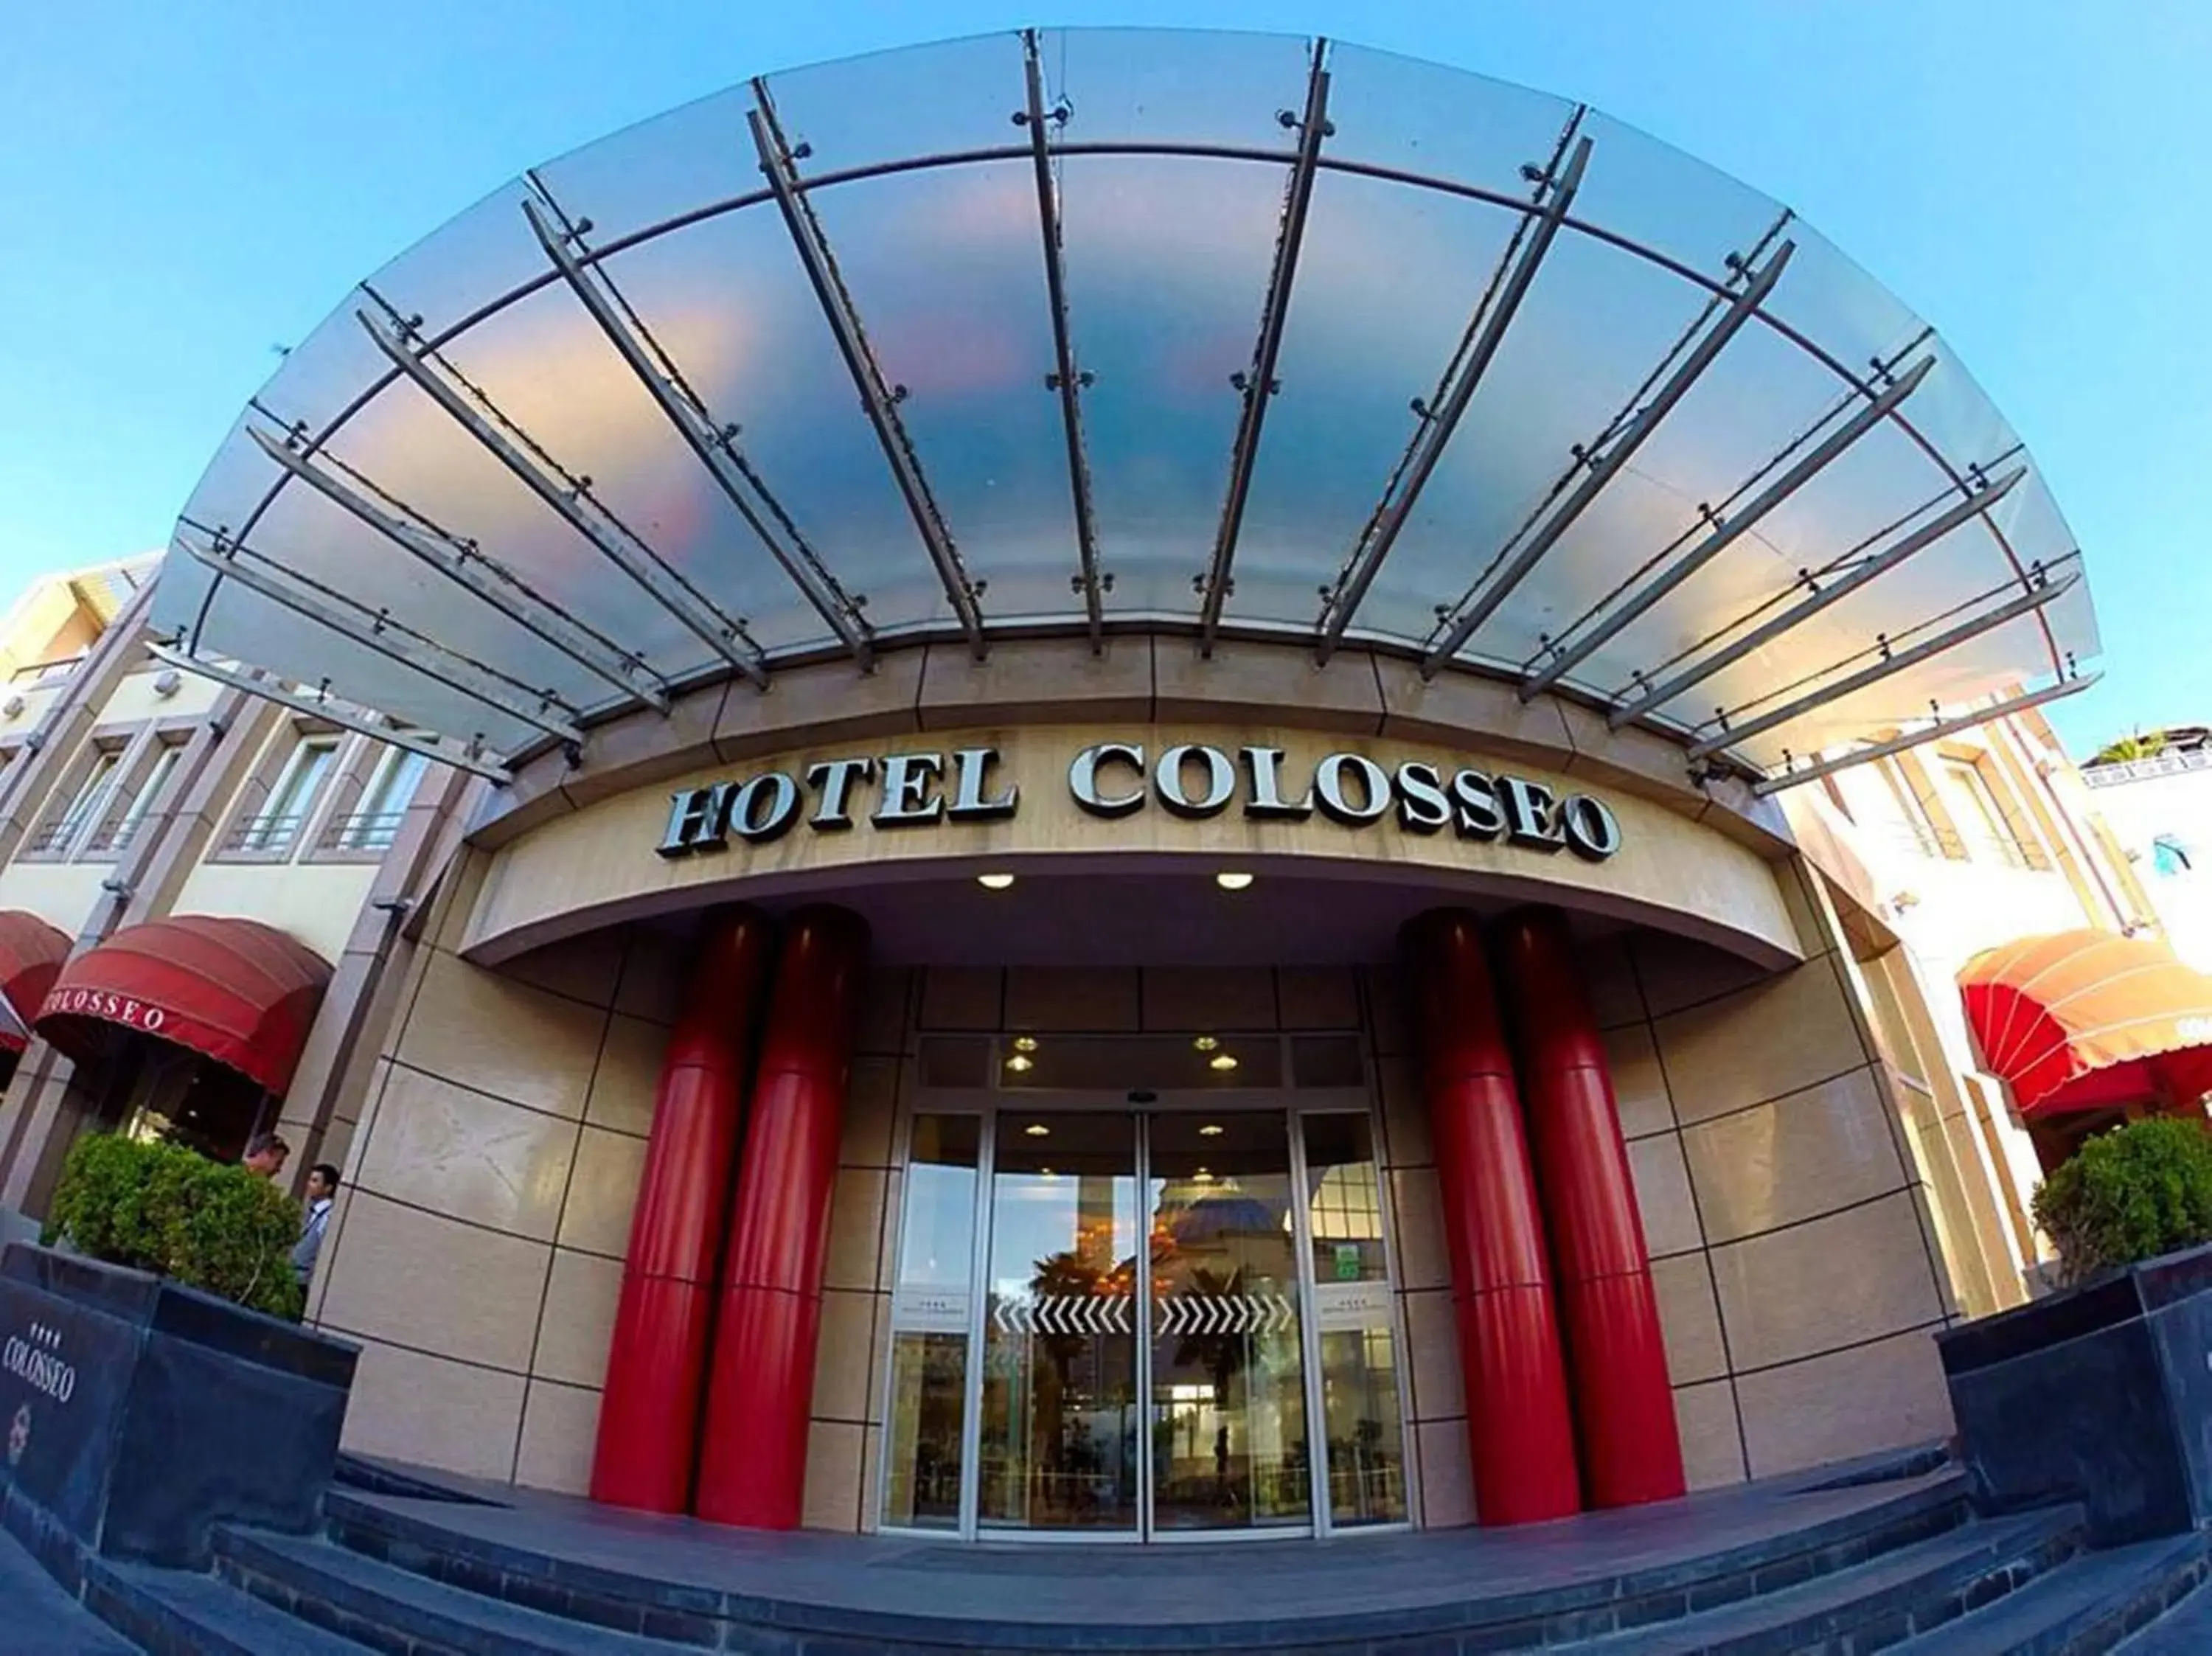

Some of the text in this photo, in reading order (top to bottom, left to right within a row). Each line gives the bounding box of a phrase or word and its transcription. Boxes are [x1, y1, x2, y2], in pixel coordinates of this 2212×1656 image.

[655, 743, 1621, 862] HOTEL COLOSSEO
[3, 1335, 75, 1402] COLOSSEO
